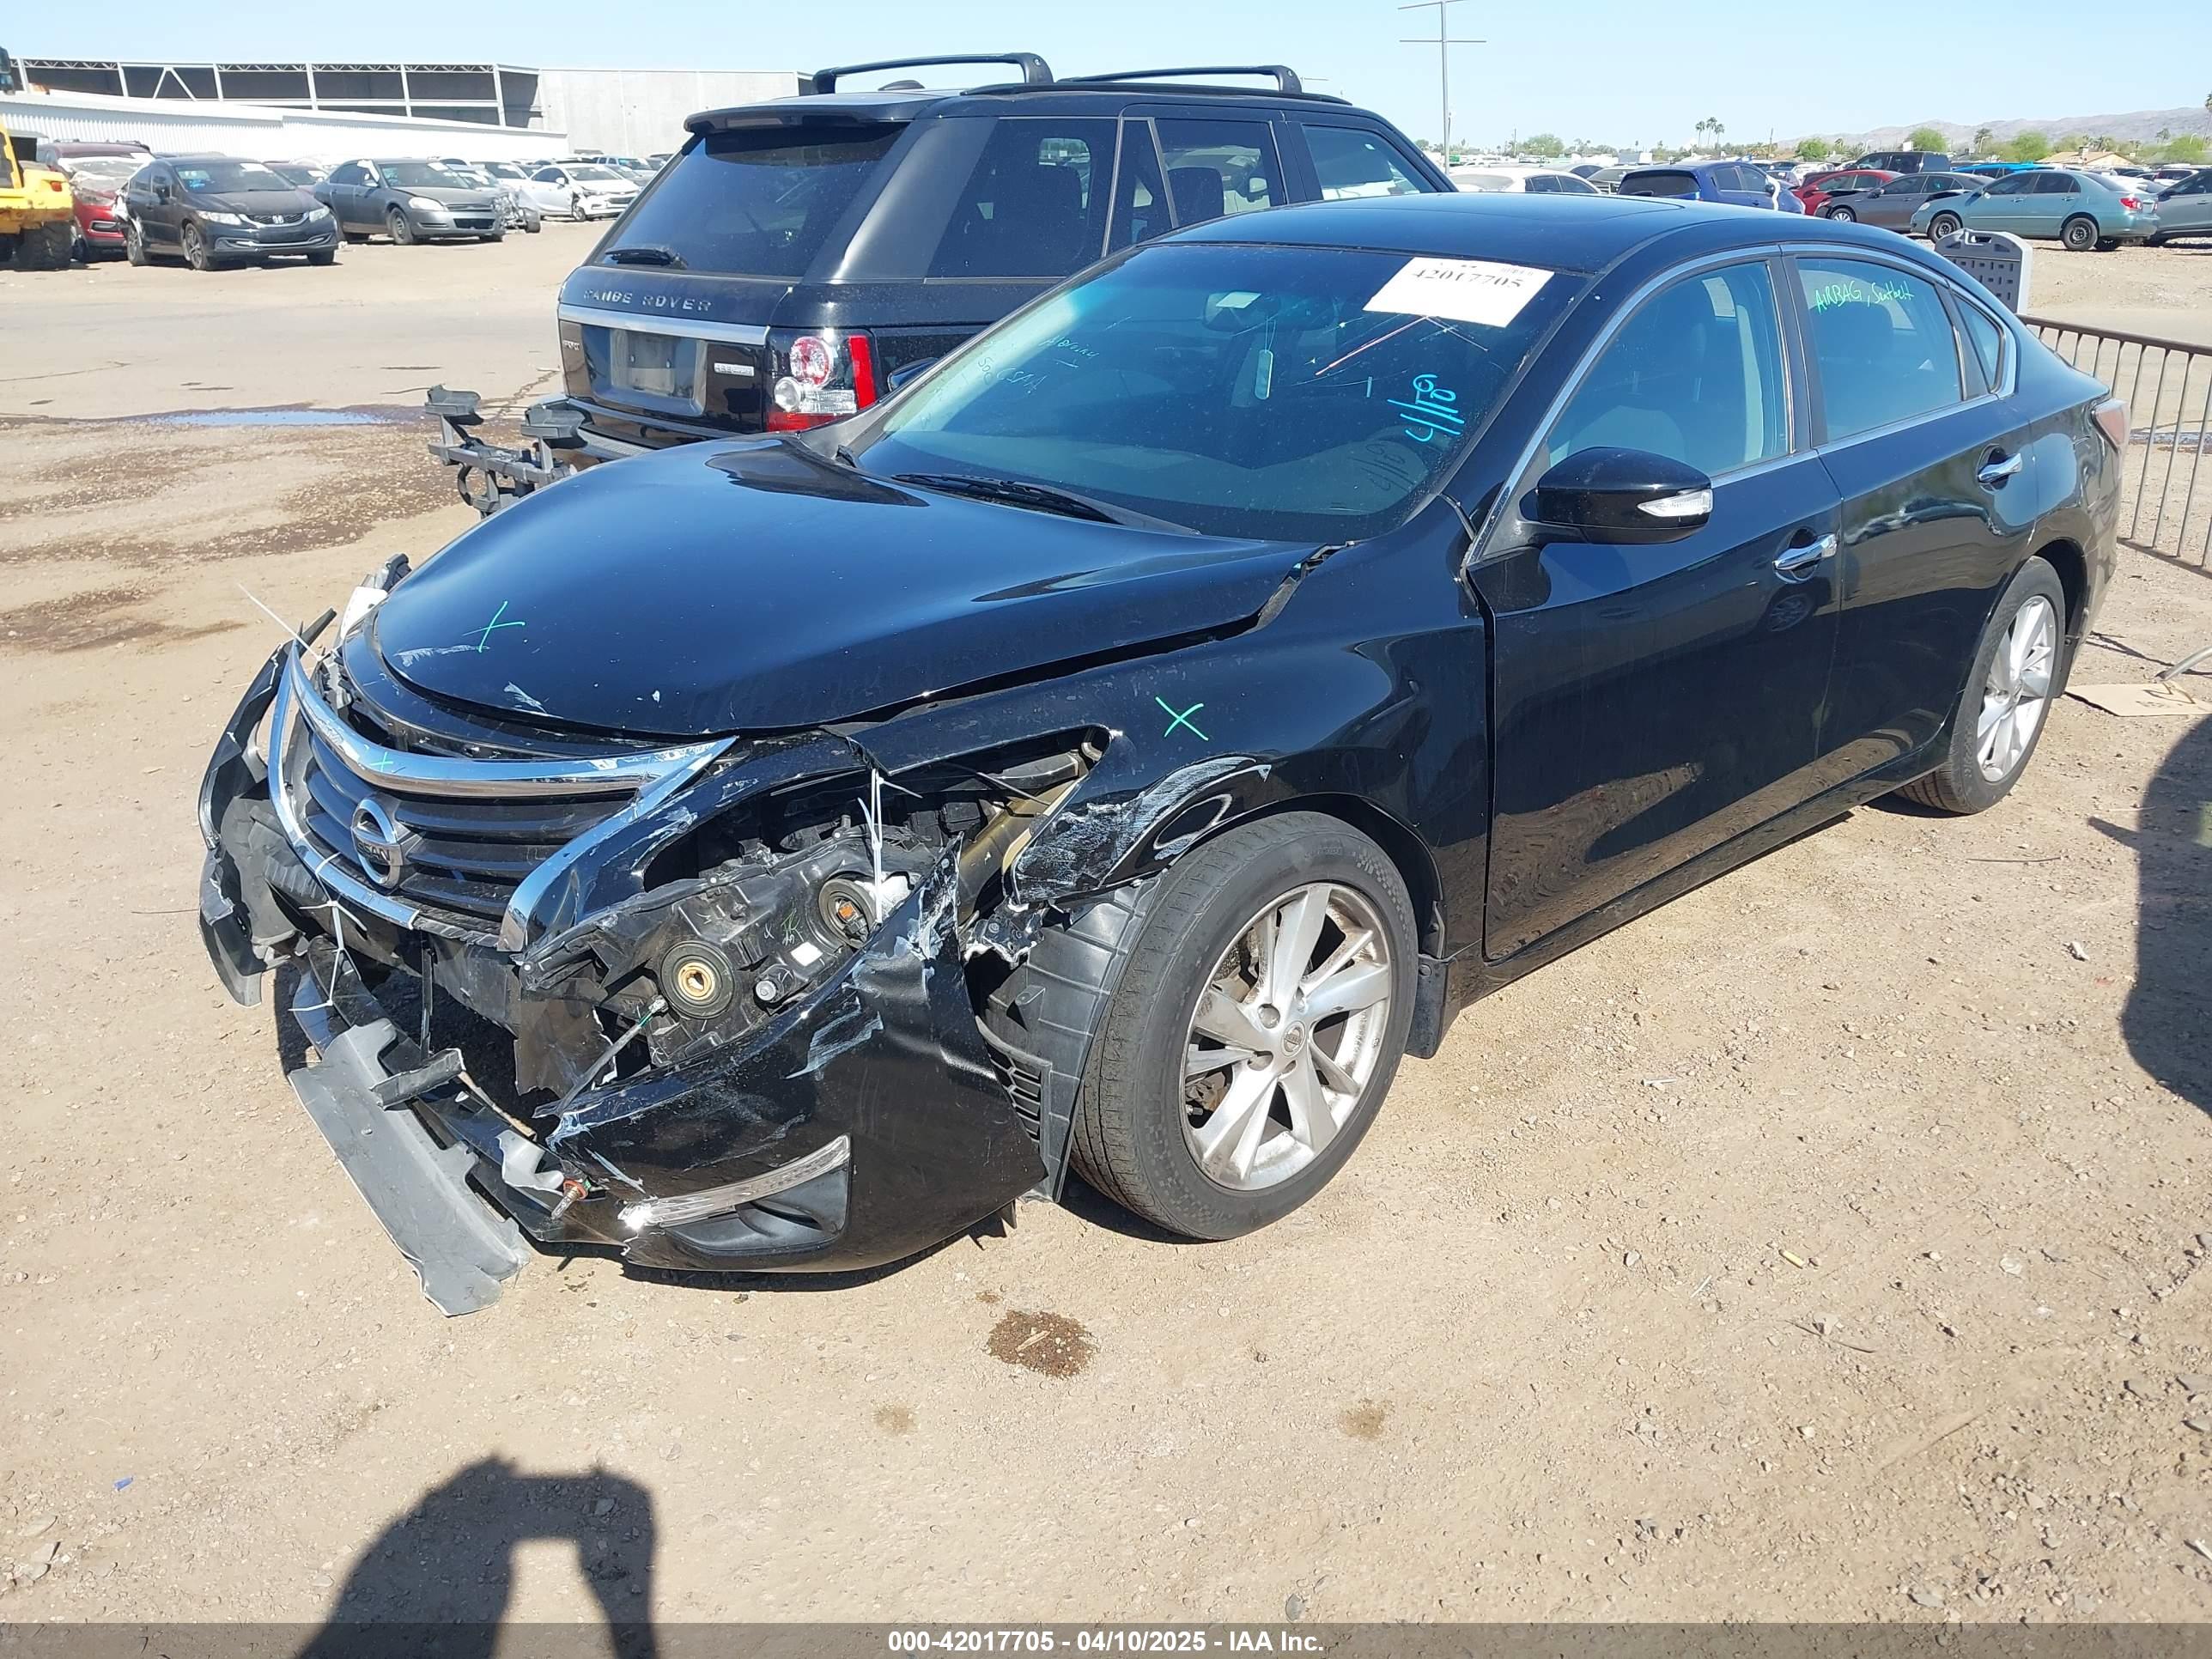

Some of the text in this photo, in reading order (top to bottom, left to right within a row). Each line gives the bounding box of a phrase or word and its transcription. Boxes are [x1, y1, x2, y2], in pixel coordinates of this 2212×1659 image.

[1412, 269, 1523, 288] 42017705
[583, 289, 712, 313] RANGE ROVER
